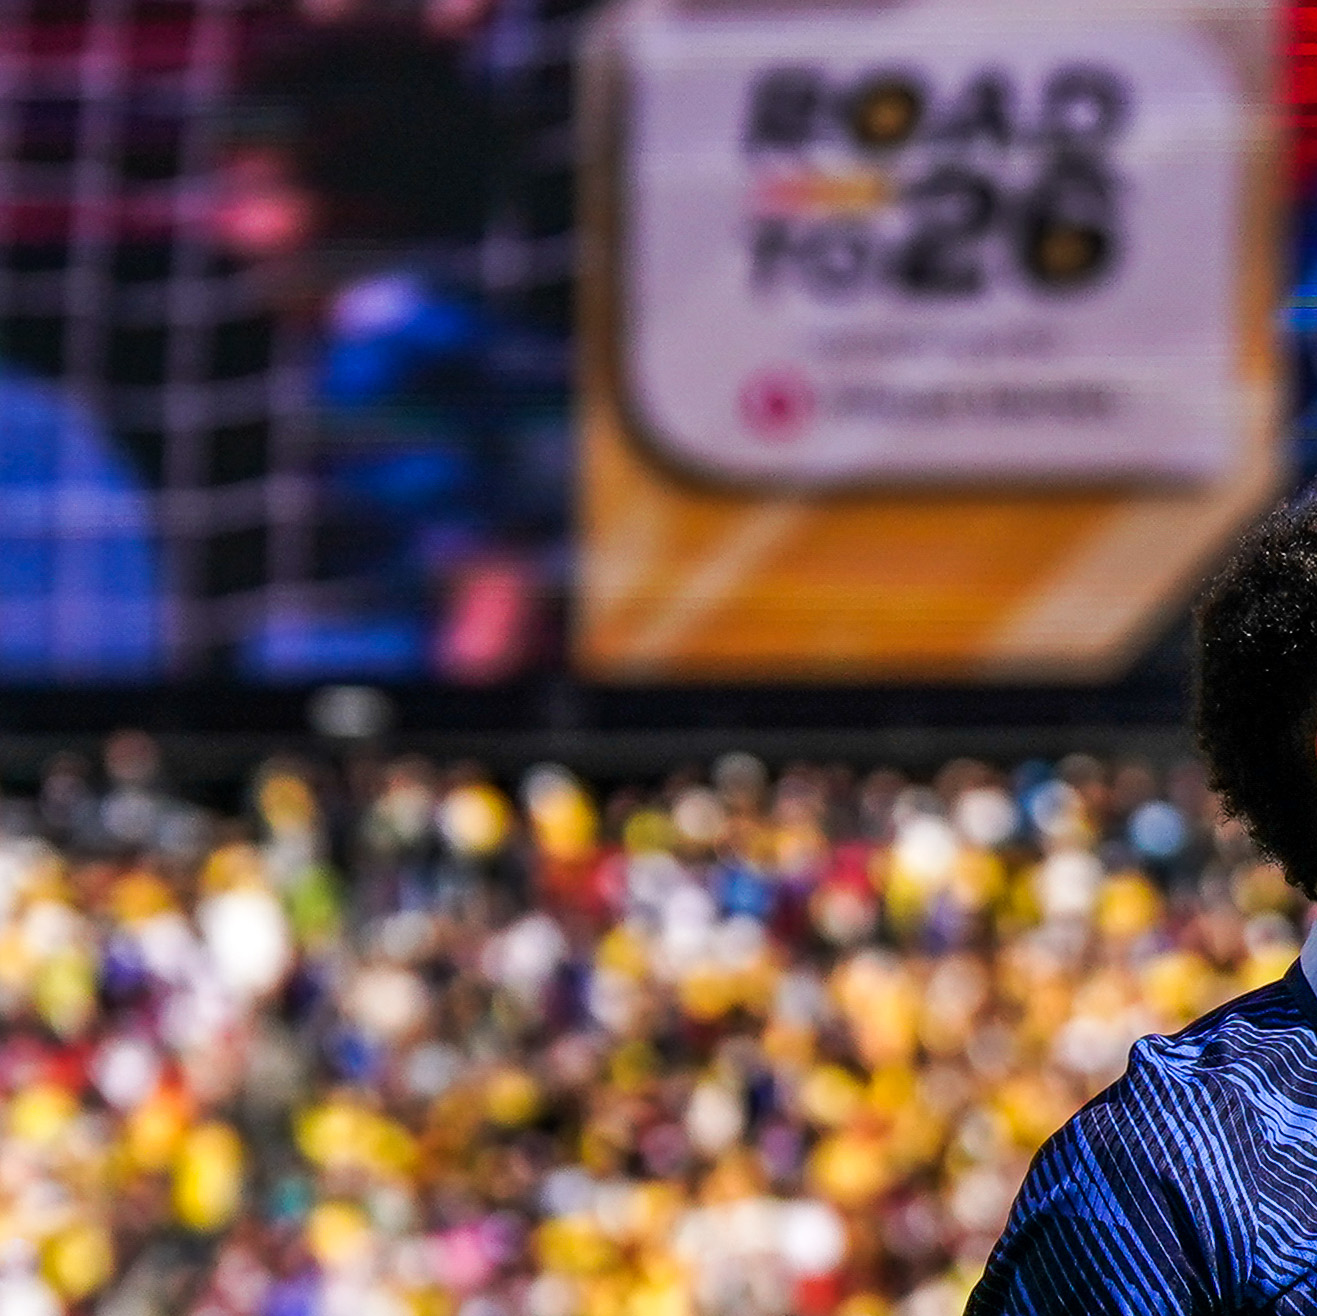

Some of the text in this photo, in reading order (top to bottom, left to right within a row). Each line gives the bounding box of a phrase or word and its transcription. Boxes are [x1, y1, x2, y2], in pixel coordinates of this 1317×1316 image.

[746, 62, 1130, 154] ROAD
[750, 158, 1120, 300] TO 26
